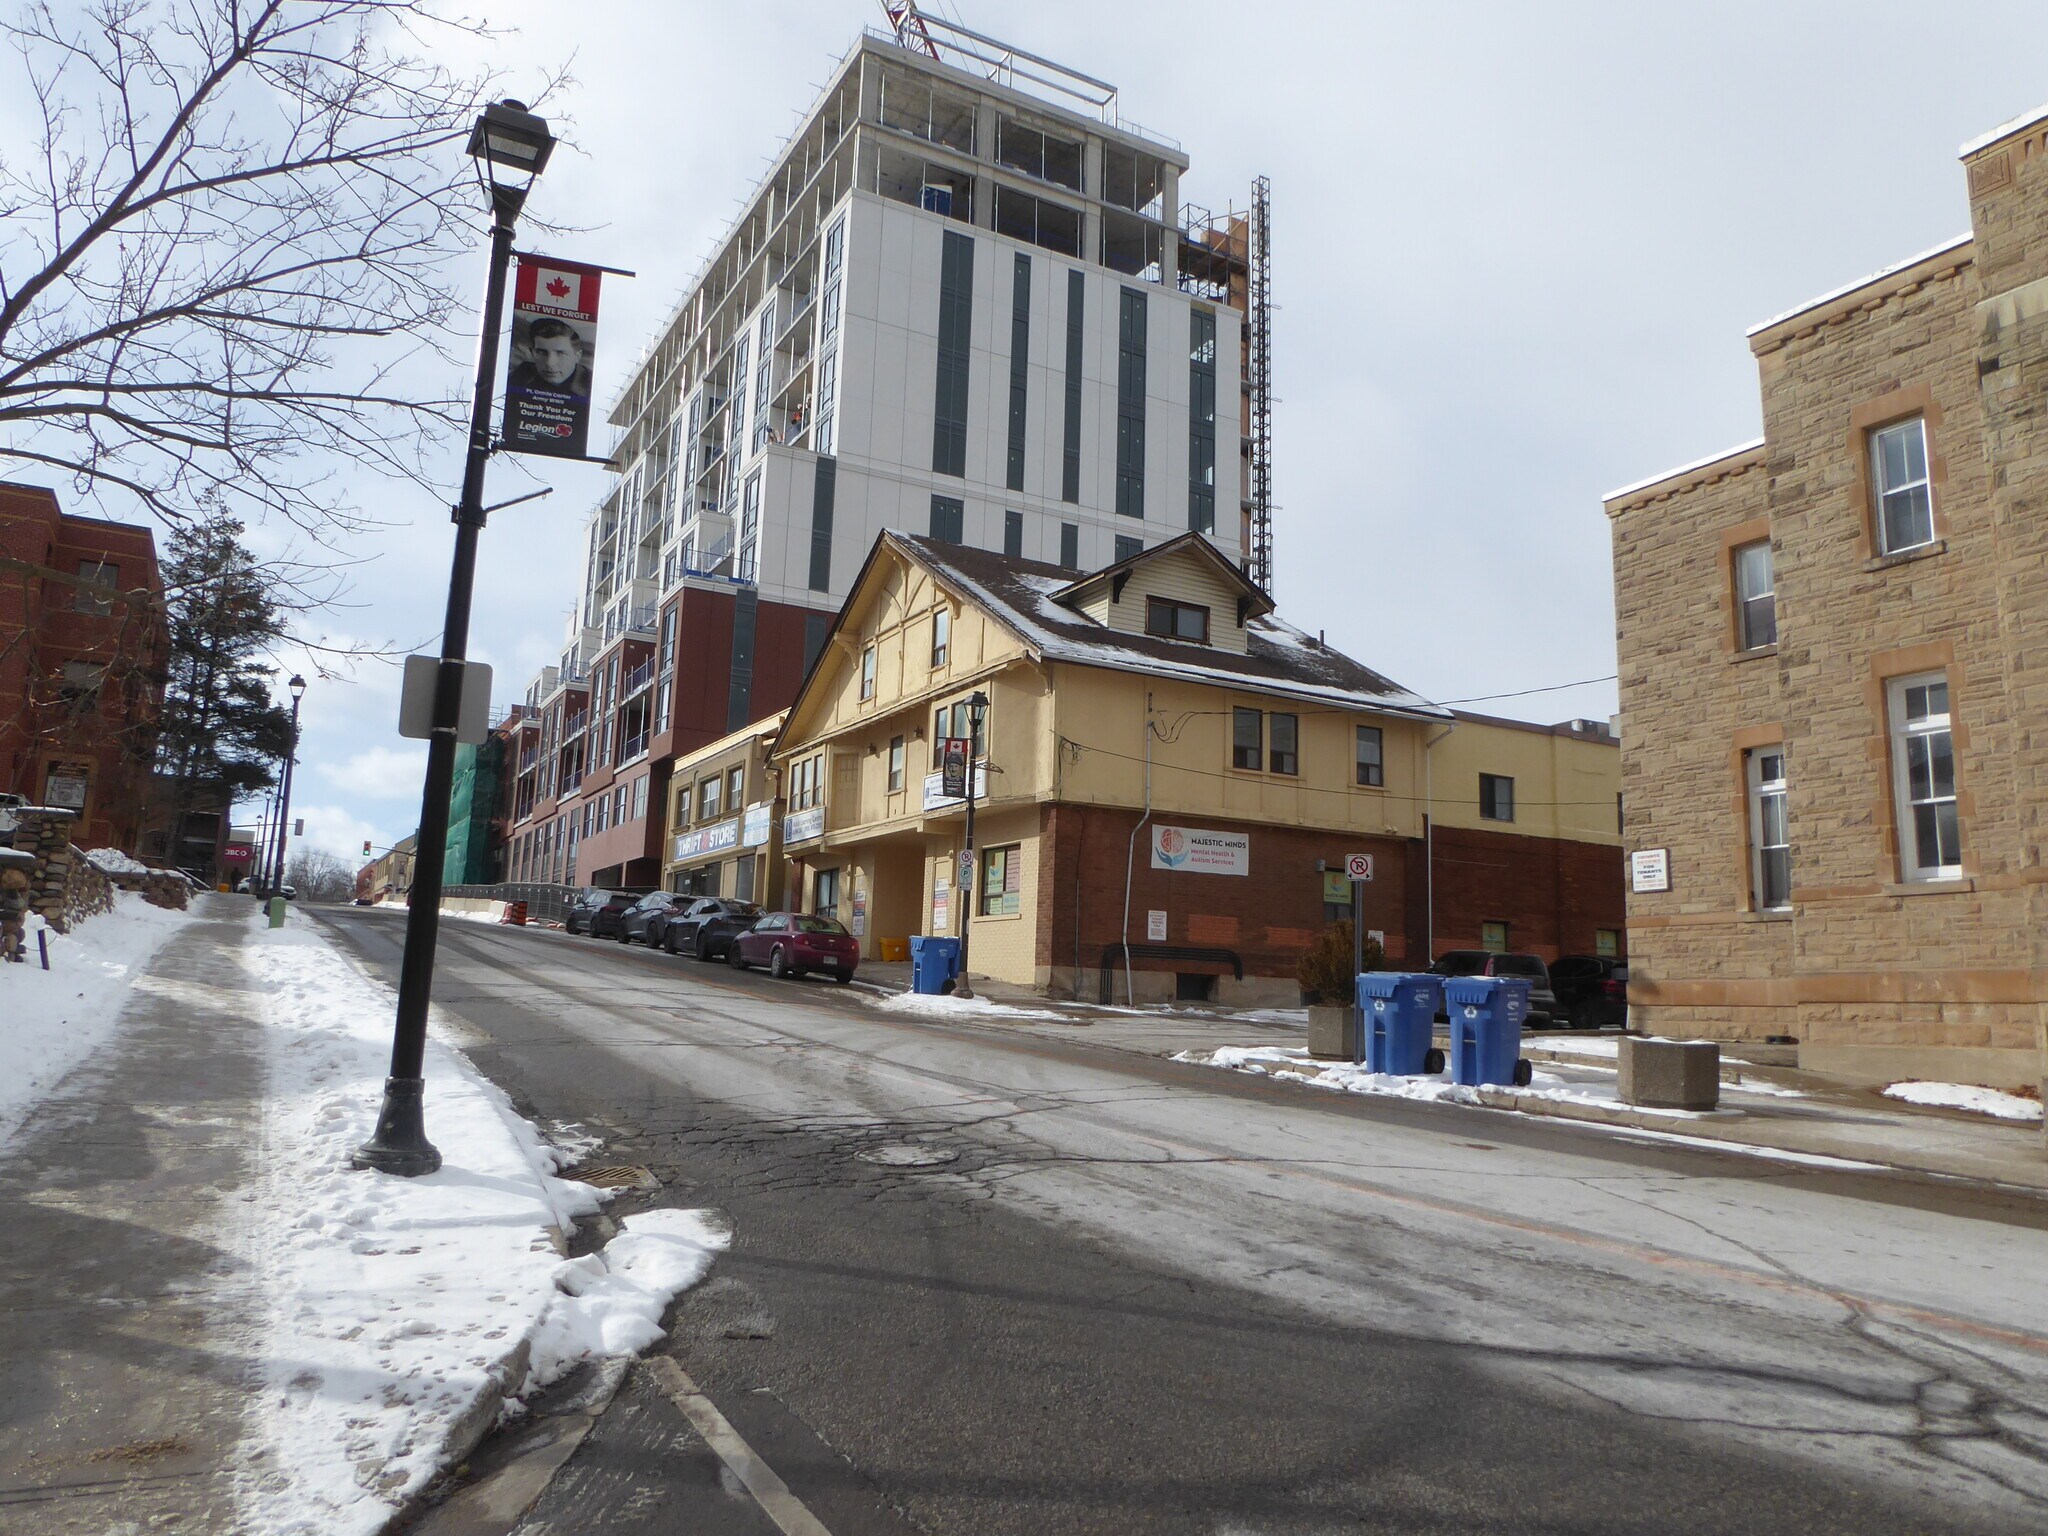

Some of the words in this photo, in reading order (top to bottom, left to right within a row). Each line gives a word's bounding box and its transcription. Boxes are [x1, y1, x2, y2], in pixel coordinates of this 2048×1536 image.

[521, 302, 542, 313] LEST
[542, 306, 557, 316] WE
[557, 309, 591, 321] FORGET
[518, 401, 544, 411] Thank
[545, 405, 561, 414] You
[562, 408, 577, 416] For
[520, 409, 536, 417] Our
[537, 411, 573, 422] Freedom
[518, 420, 555, 434] Legion
[677, 834, 702, 857] THRIFT
[709, 823, 736, 848] STORE
[1190, 838, 1223, 847] MAJESTIC
[1224, 841, 1247, 849] MINDS
[1190, 848, 1210, 857] Mental
[1211, 850, 1229, 858] Health
[1211, 858, 1235, 866] Services
